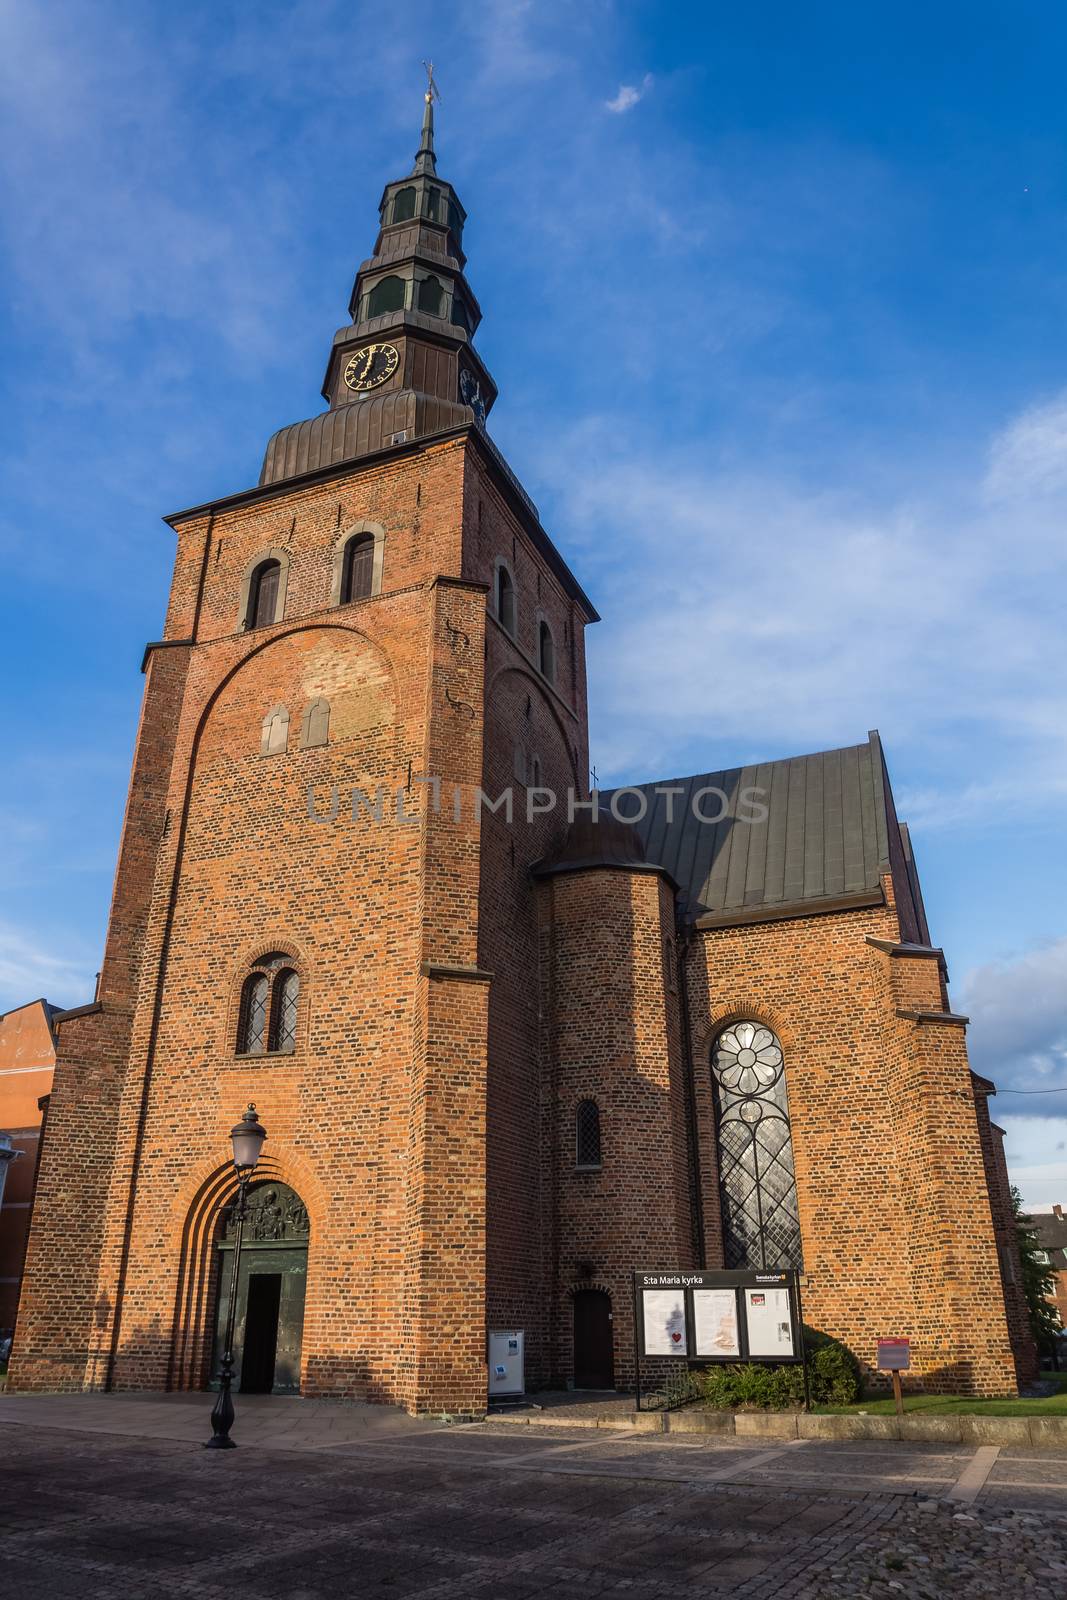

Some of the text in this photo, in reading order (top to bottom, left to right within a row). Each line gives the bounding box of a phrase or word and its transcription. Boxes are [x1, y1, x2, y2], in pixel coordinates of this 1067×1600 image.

[359, 350, 366, 359] 11
[349, 360, 358, 368] 10
[357, 381, 364, 389] 7
[643, 1275, 703, 1286] S:ta Maria kyrka
